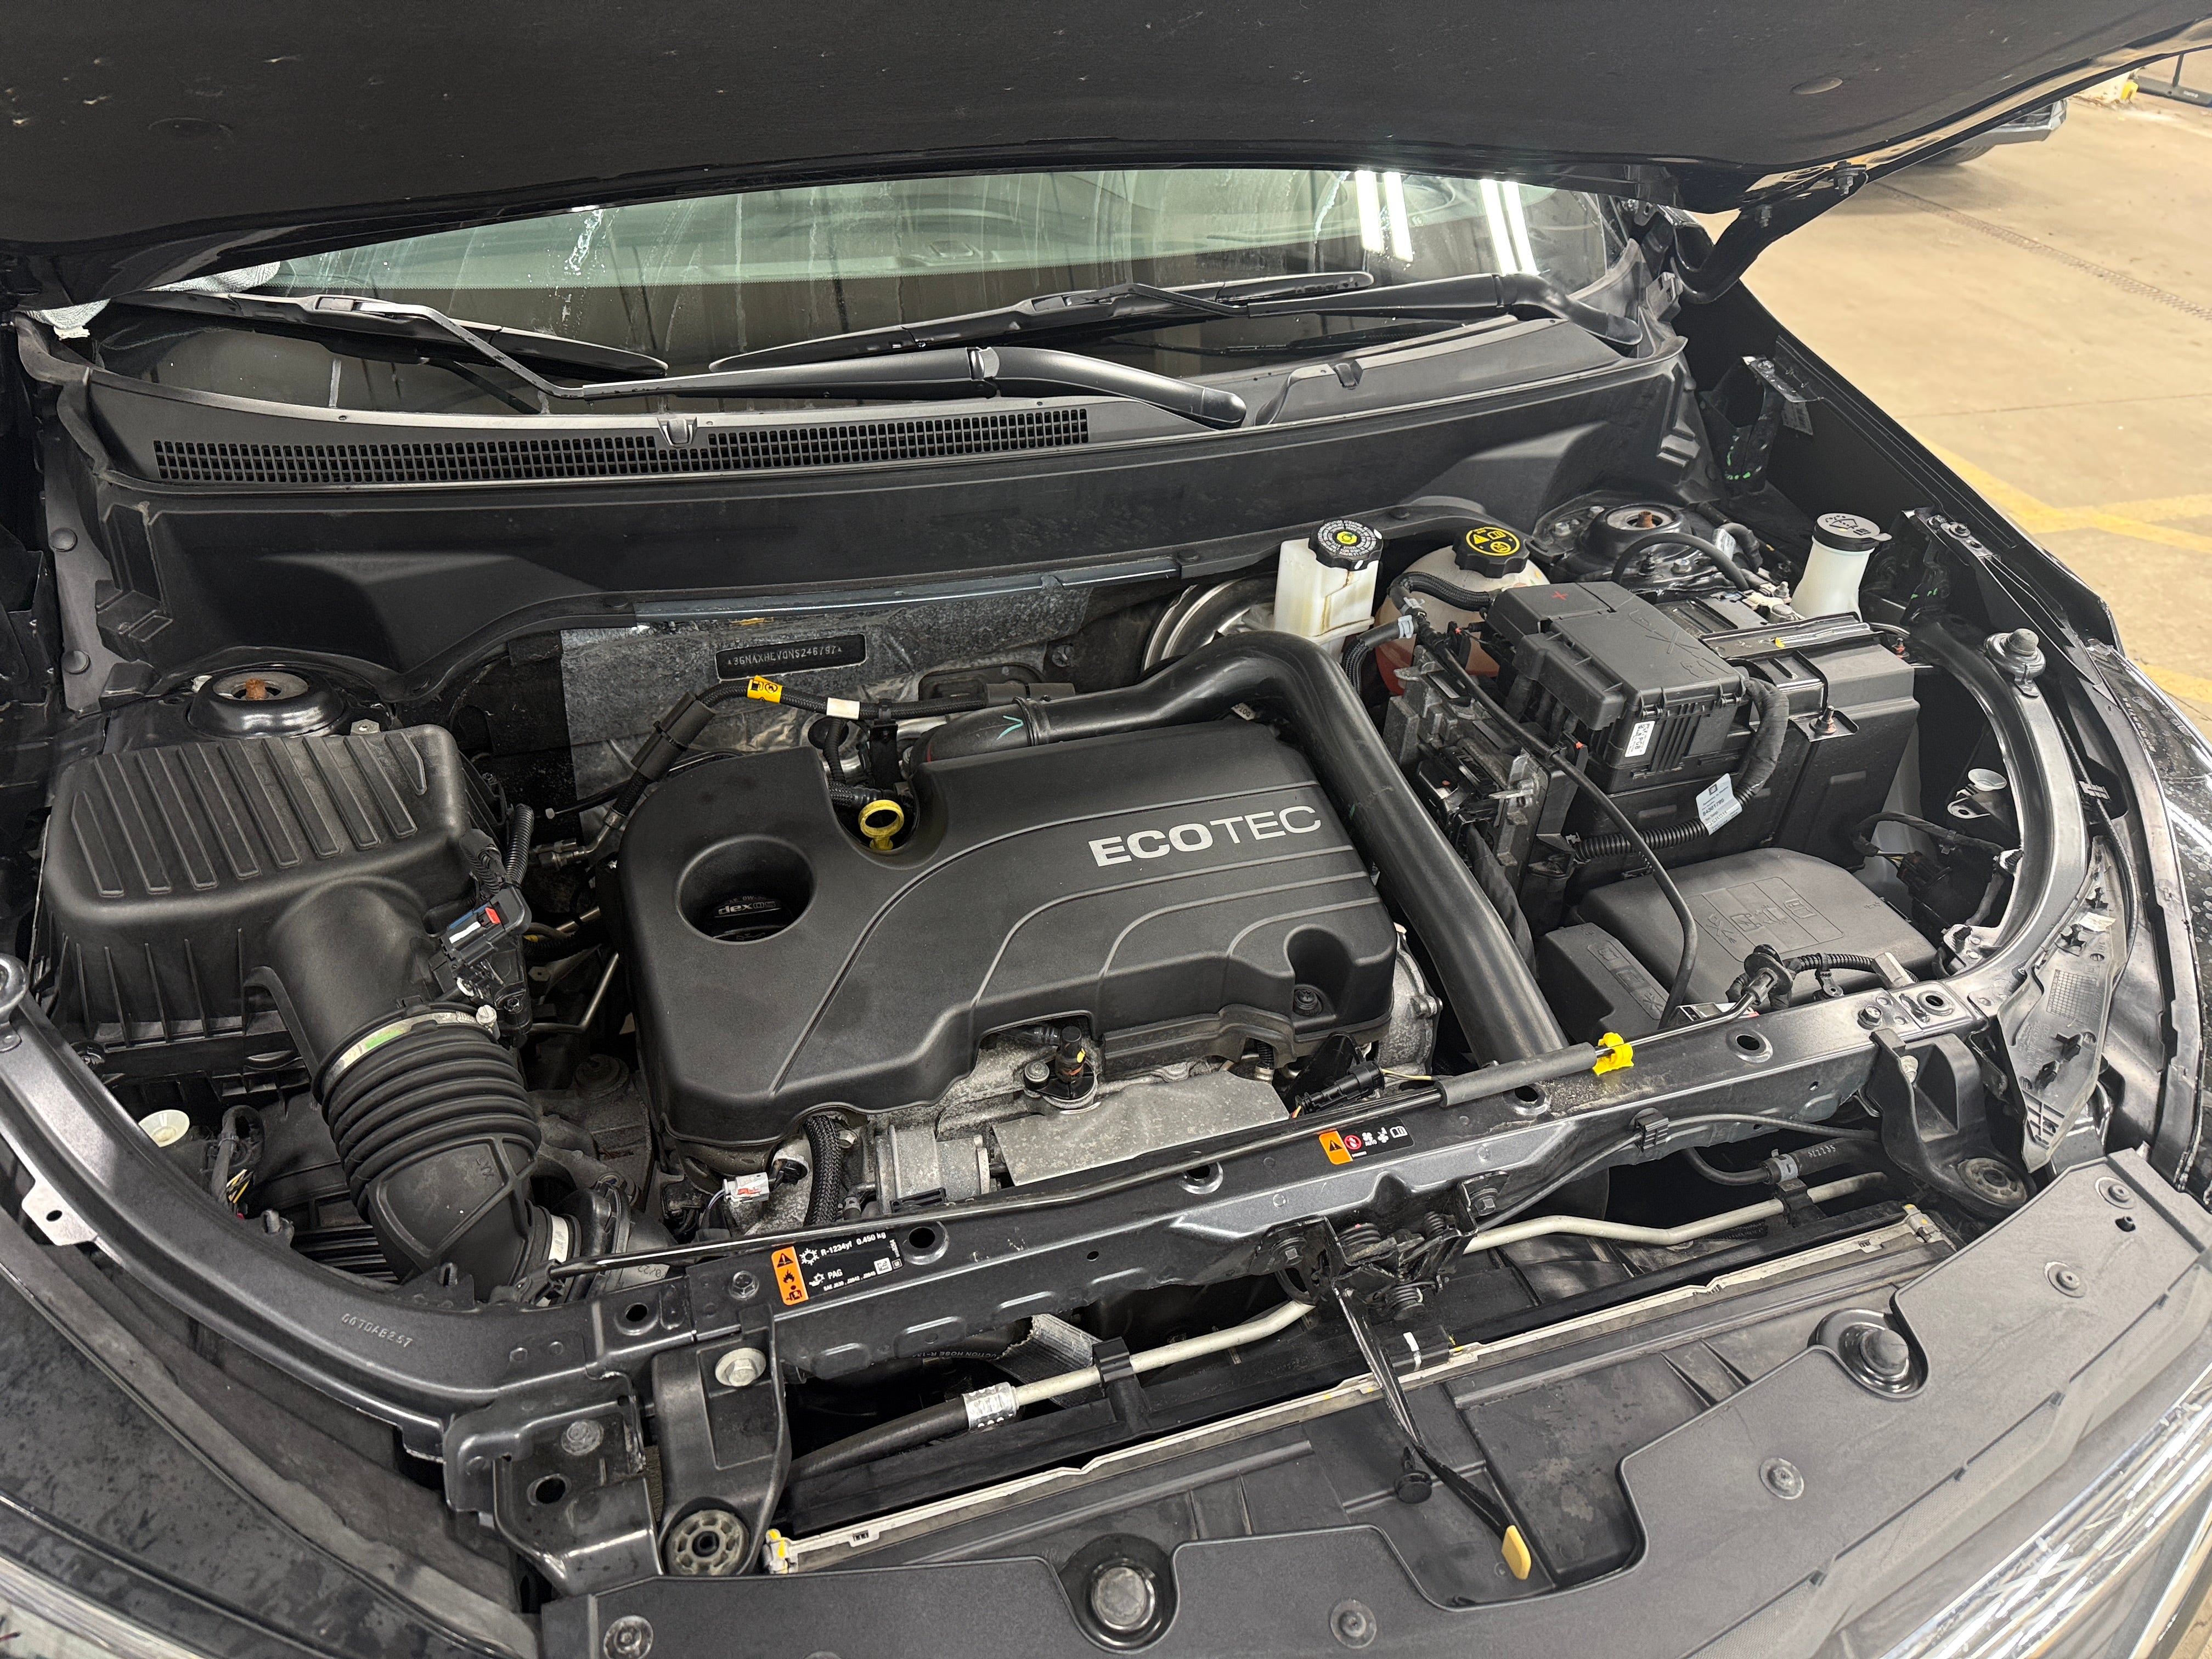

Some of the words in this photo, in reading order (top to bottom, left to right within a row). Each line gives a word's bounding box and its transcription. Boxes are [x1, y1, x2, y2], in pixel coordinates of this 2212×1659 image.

[1088, 805, 1321, 867] ECOTEC
[718, 901, 776, 915] dexos
[821, 1240, 853, 1256] R-1234yf
[856, 1234, 876, 1245] 0.450
[827, 1269, 843, 1279] PAG
